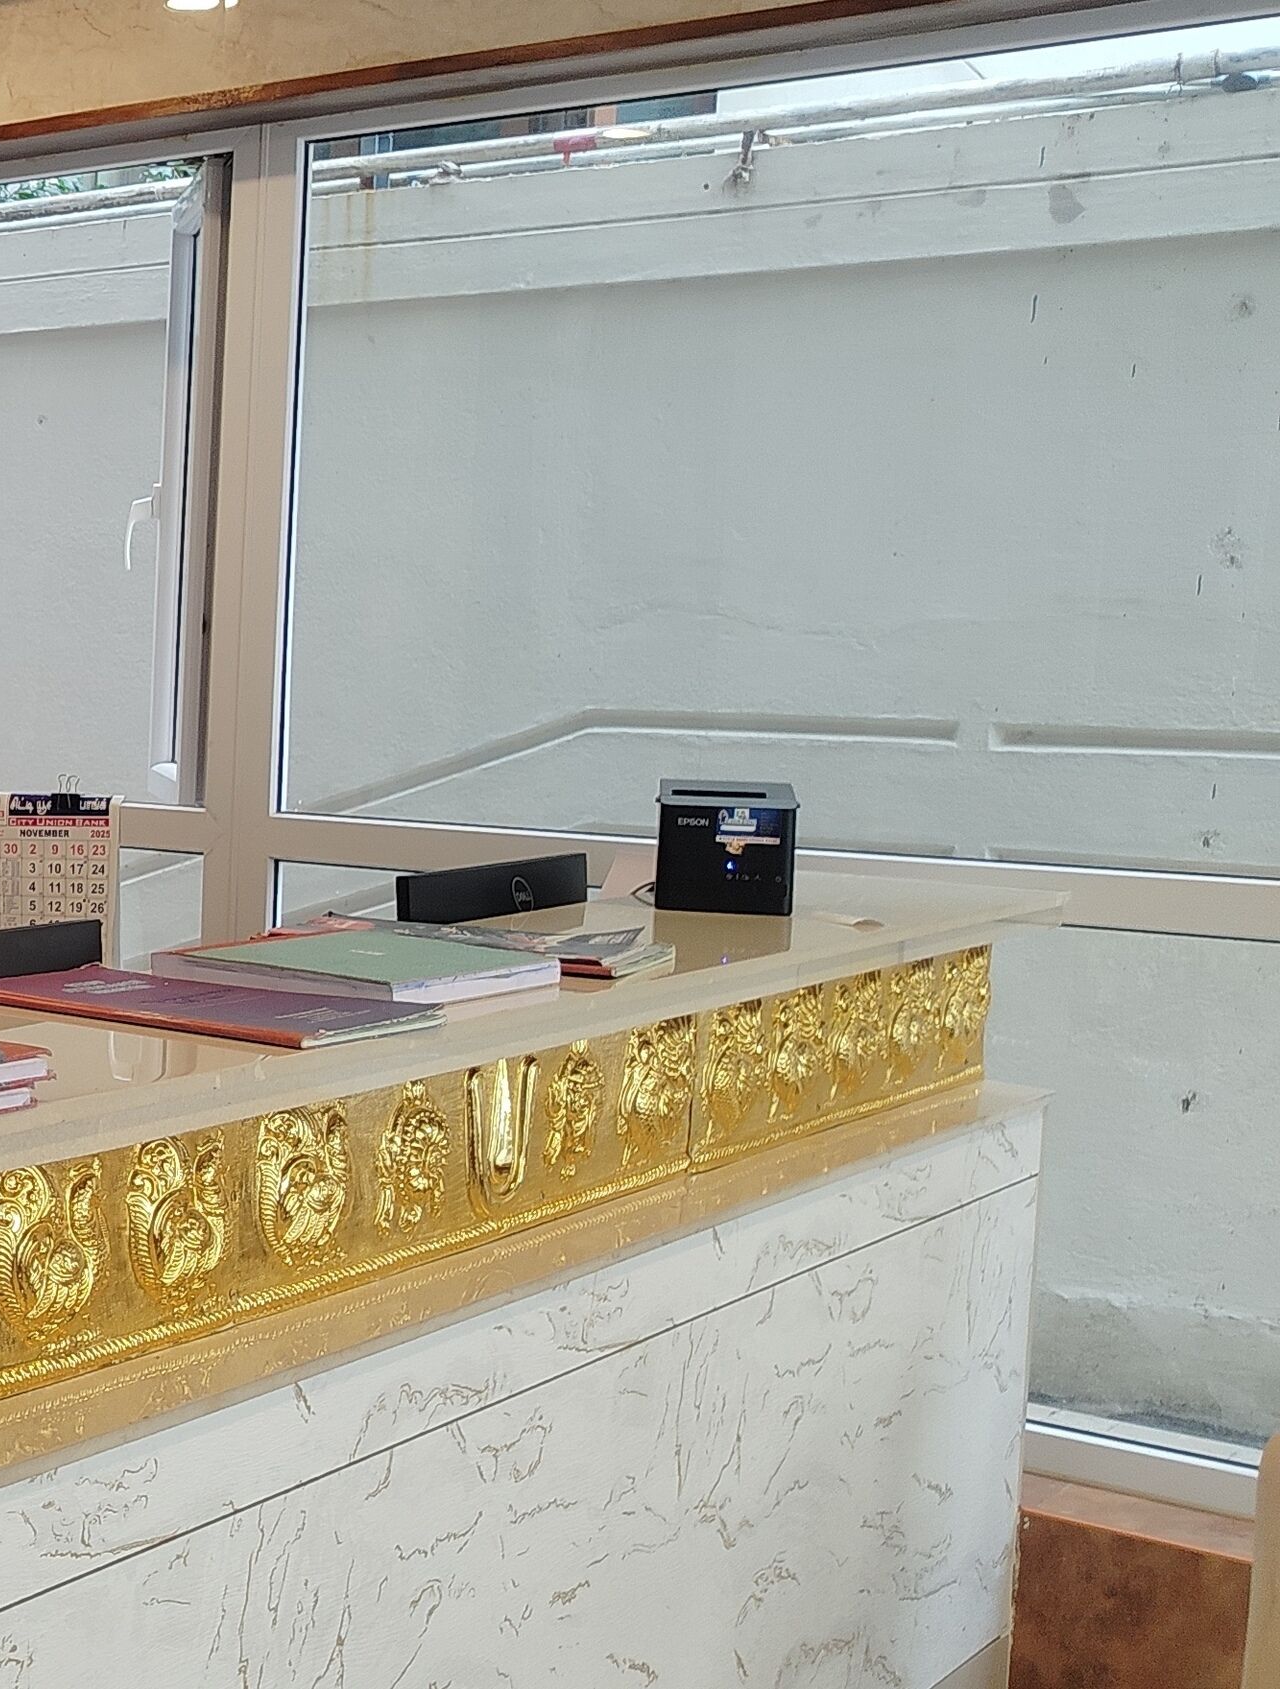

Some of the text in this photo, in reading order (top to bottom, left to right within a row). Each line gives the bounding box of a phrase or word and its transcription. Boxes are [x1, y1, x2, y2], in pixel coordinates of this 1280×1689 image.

[36, 818, 73, 826] UNION
[678, 817, 709, 826] EPSON
[20, 830, 110, 838] NOVEMBER 2025
[4, 844, 18, 855] 30
[30, 845, 36, 855] 2
[52, 845, 58, 855] 9
[71, 845, 84, 855] 16
[92, 845, 106, 855] 23
[29, 863, 36, 873] 3
[48, 863, 61, 874] 10
[70, 864, 83, 874] 17
[92, 864, 105, 874] 24
[29, 882, 36, 892] 4
[49, 882, 60, 892] 11
[70, 883, 83, 893] 18
[91, 884, 104, 894] 25
[29, 901, 36, 911] 5
[48, 901, 61, 912] 12
[70, 902, 82, 912] 19
[90, 903, 104, 913] 26
